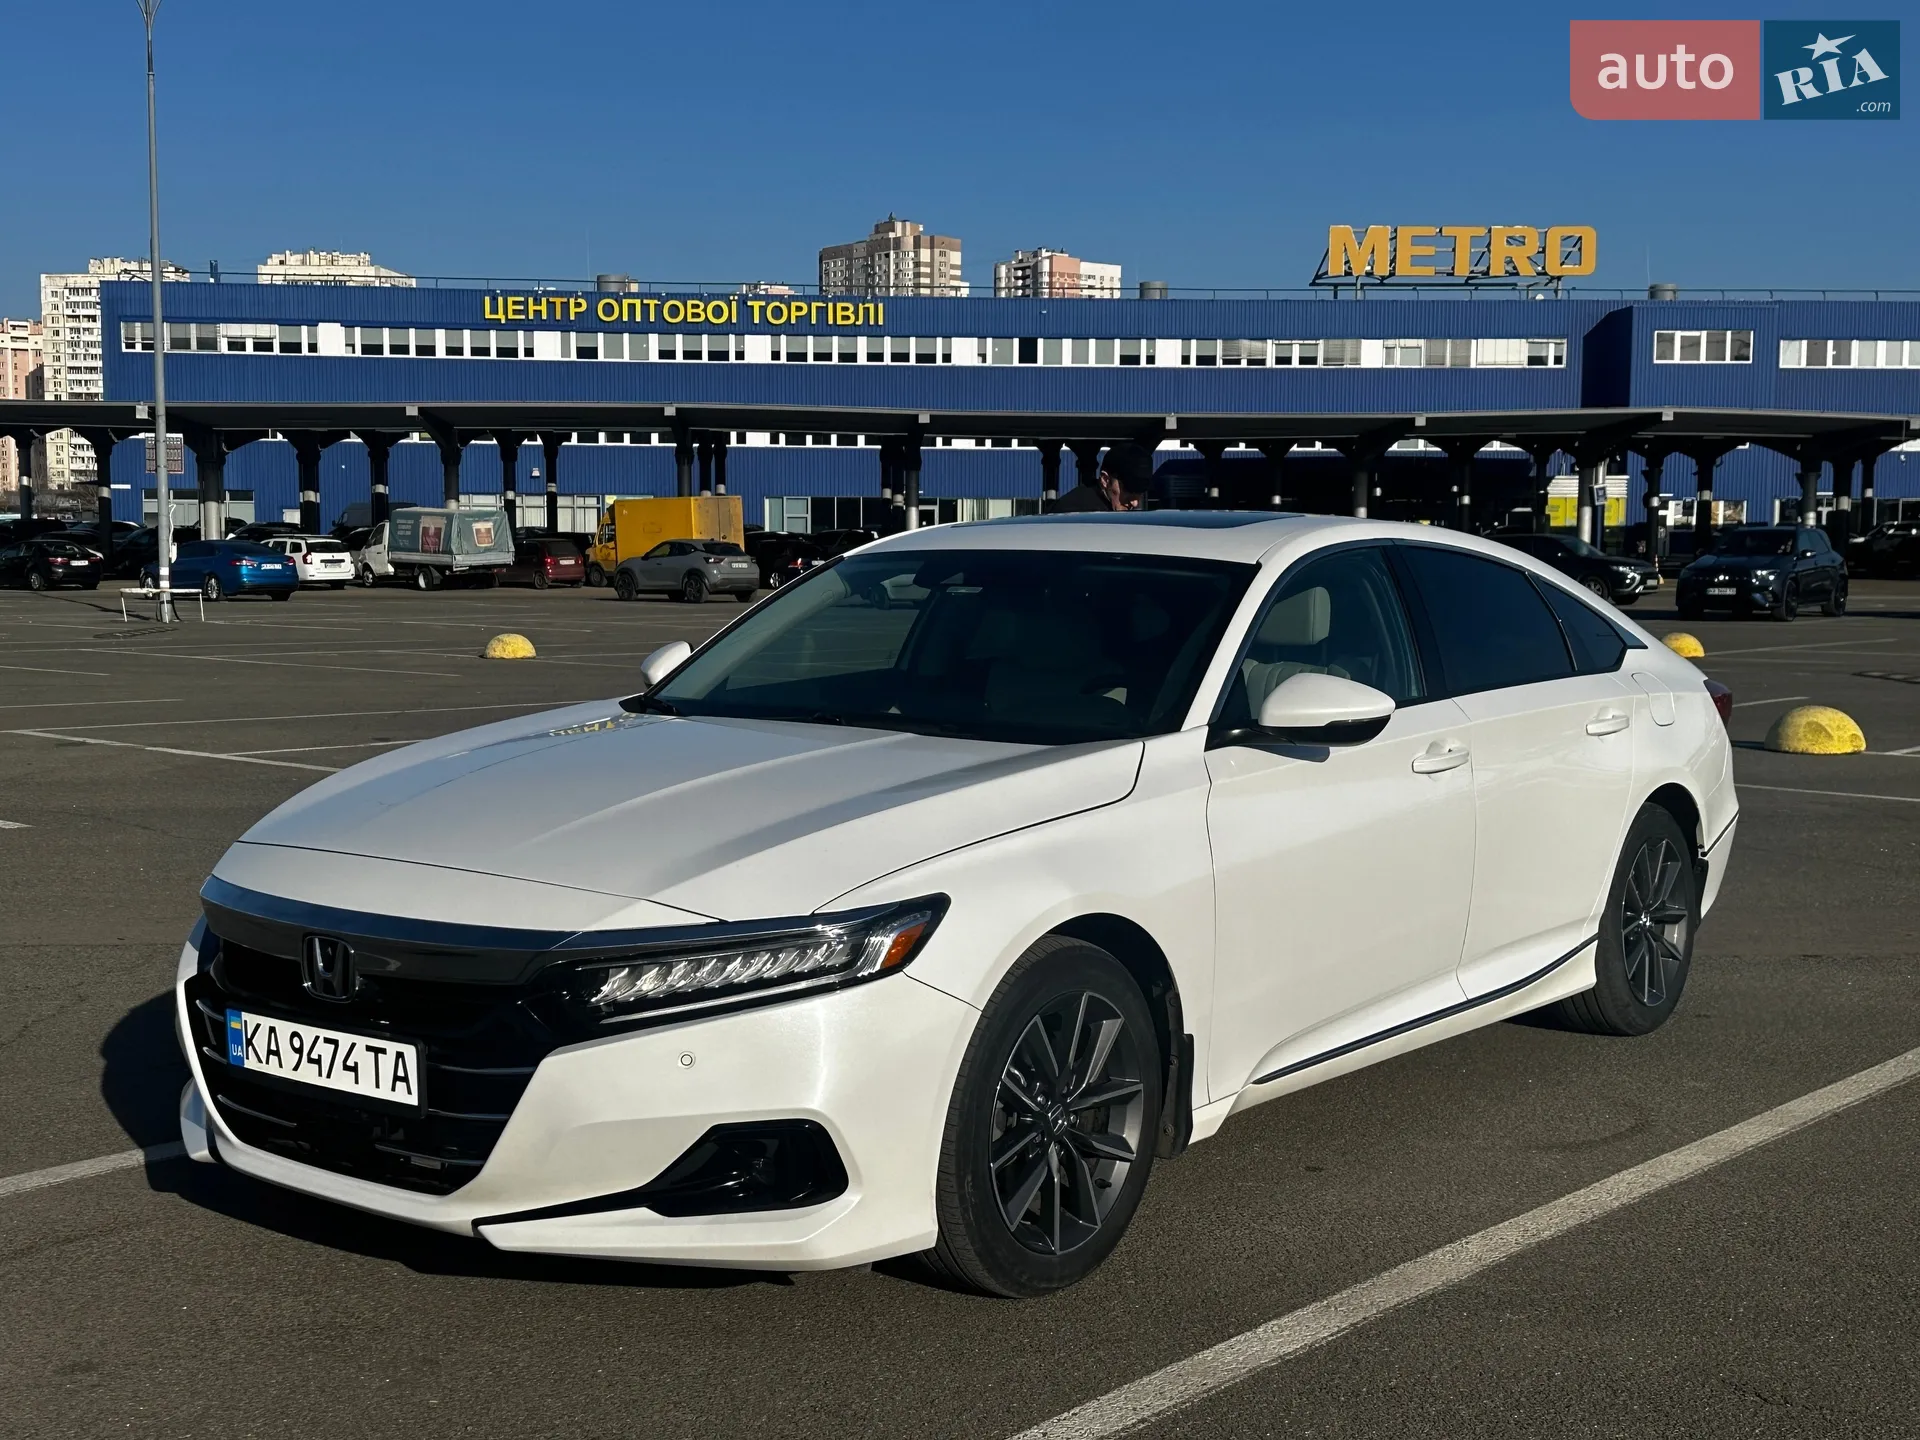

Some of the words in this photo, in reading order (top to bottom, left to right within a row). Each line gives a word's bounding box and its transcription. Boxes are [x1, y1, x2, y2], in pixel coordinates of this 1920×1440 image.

[1328, 225, 1597, 277] METRO
[484, 296, 588, 324] ЦЕНТР
[597, 295, 738, 325] ОПТОВОЇ
[748, 300, 884, 326] ТОРГІВЛІ
